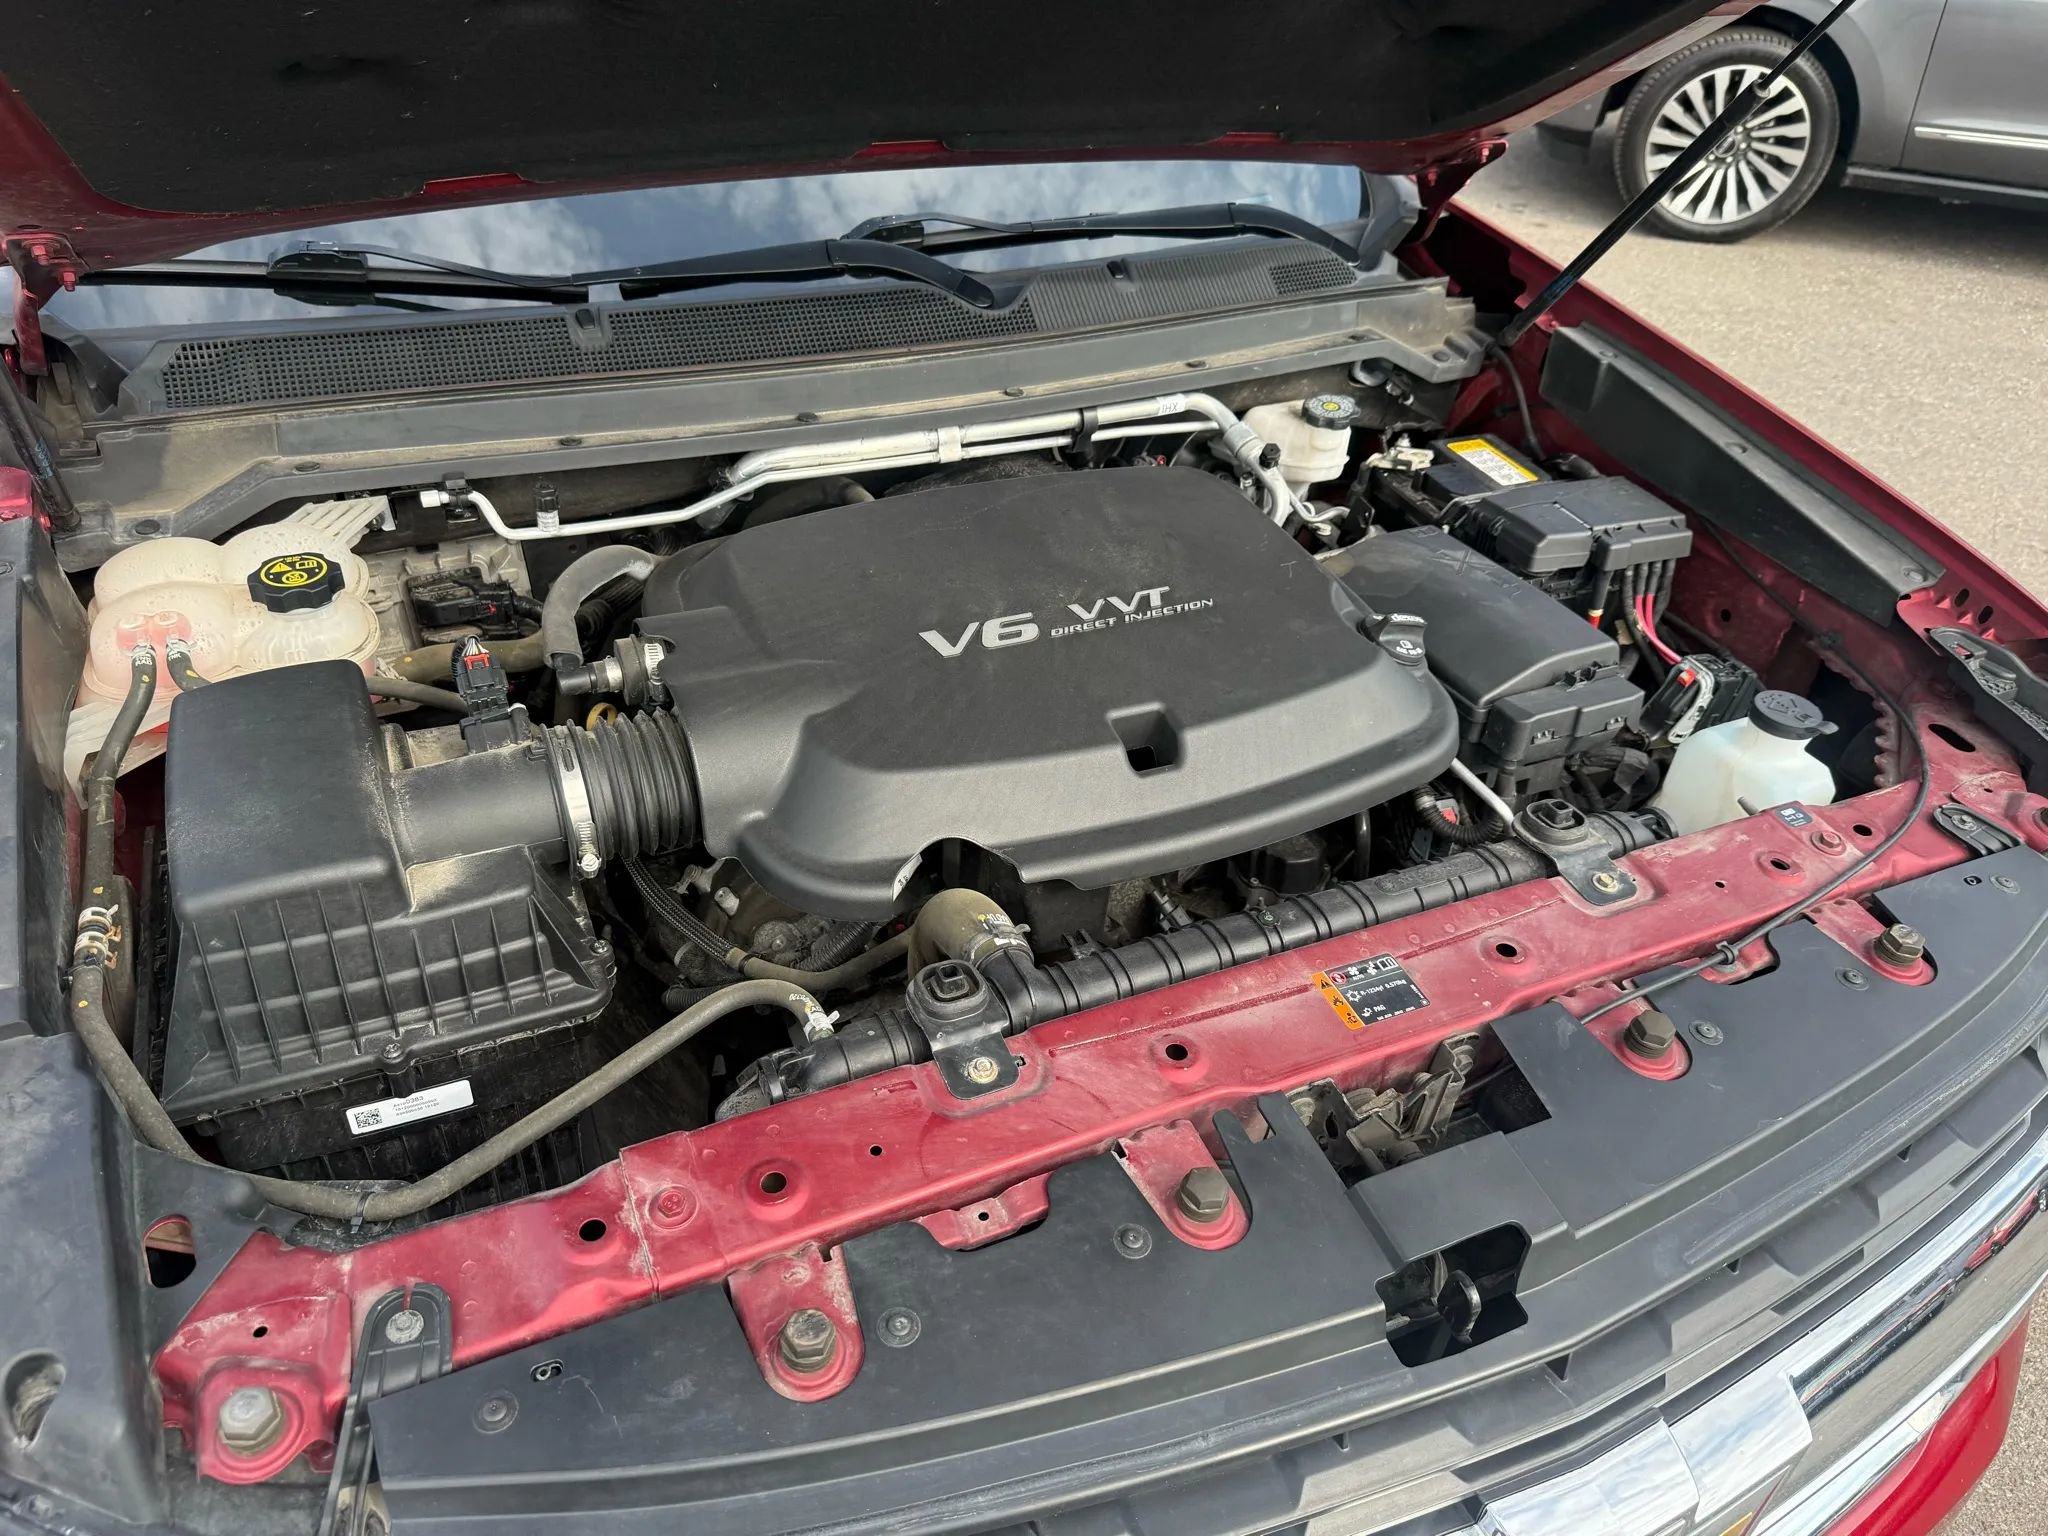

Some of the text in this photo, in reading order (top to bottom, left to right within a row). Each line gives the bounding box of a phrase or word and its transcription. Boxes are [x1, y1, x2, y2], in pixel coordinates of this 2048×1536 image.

[1050, 597, 1214, 638] DIRECT INJECTION
[1065, 585, 1170, 621] VVT
[917, 611, 1041, 658] V6
[1373, 1003, 1387, 1013] PAG
